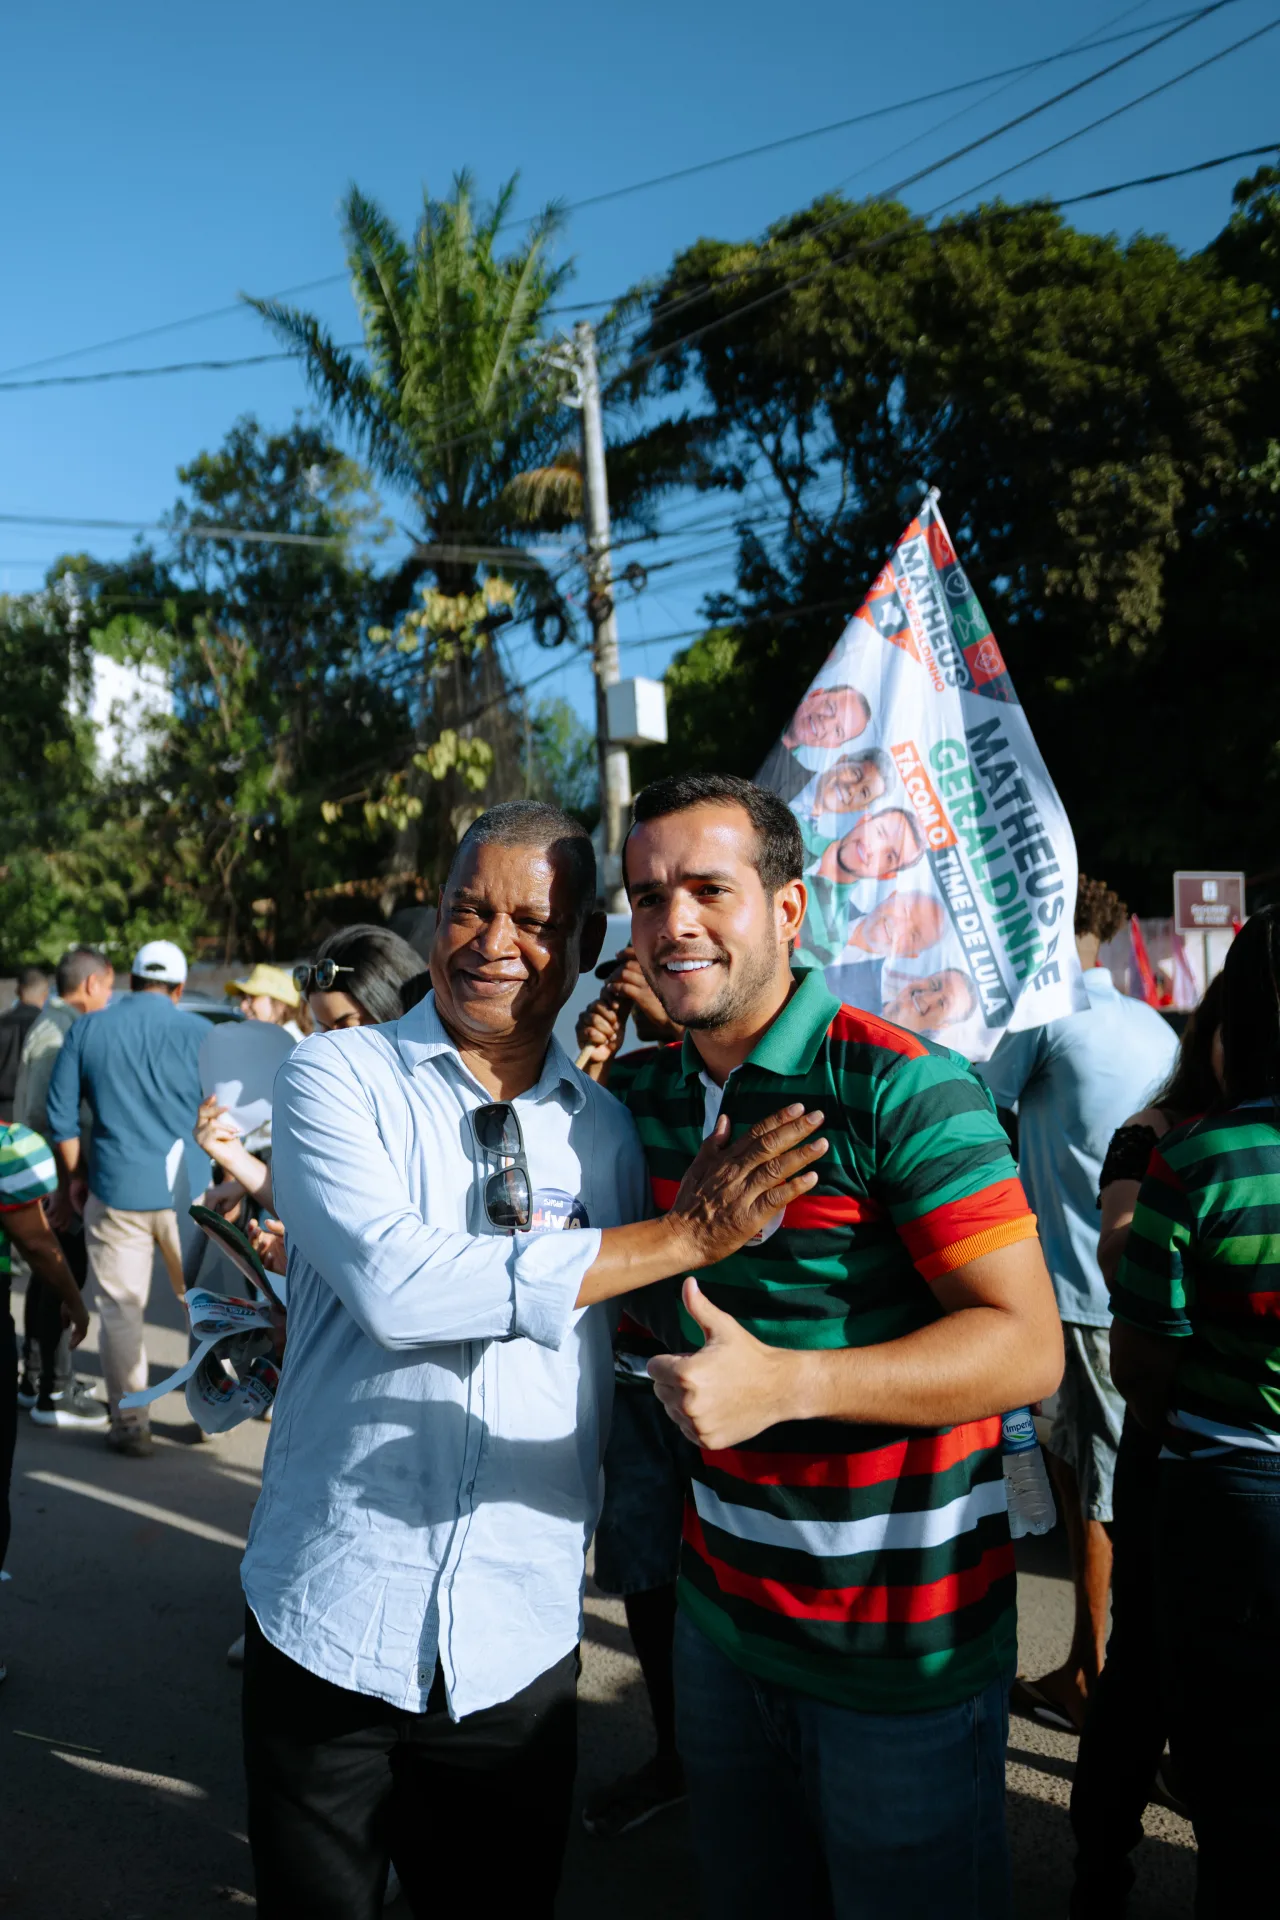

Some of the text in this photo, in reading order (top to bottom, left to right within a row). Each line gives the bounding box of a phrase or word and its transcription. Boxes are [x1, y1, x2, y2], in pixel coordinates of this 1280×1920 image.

[897, 577, 908, 597] DE
[906, 600, 945, 693] GERALDINHO
[901, 541, 967, 687] MATHEUS
[895, 746, 1007, 1016] TÁ COM O TIME DE LULA
[929, 738, 1045, 982] GERALDINH
[965, 716, 1064, 926] MATHEUS
[1005, 1419, 1032, 1434] Imperia
